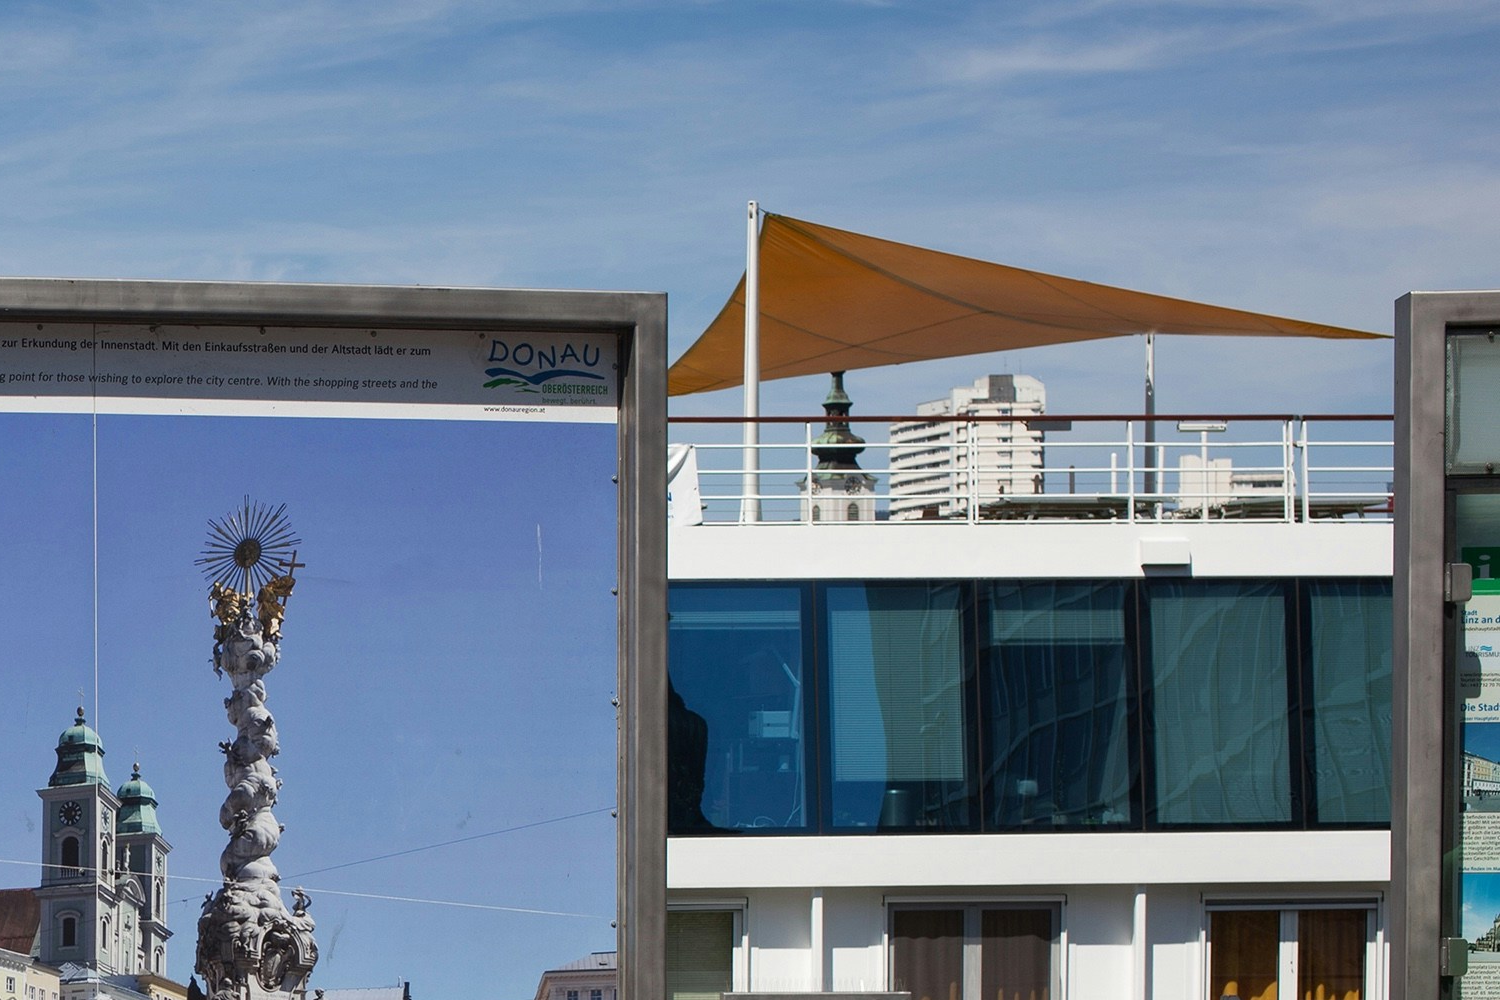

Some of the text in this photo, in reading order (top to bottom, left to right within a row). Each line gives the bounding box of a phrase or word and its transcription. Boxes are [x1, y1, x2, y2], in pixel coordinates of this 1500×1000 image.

[1, 341, 18, 349] zur
[21, 339, 77, 351] Erkundung
[80, 340, 98, 350] der
[101, 340, 159, 351] Innenstadt.
[161, 341, 180, 351] Mit
[182, 341, 202, 352] den
[204, 342, 287, 353] Einkaufsstraßen
[289, 343, 309, 354] und
[311, 343, 329, 354] der
[331, 344, 372, 354] Altstadt
[374, 345, 394, 355] lädt
[396, 347, 407, 355] er
[409, 348, 431, 356] zum
[488, 339, 600, 370] DONAU
[8, 372, 36, 385] point
[37, 373, 54, 383] for
[56, 373, 85, 383] those
[88, 373, 128, 386] wishing
[131, 374, 142, 384] to
[144, 374, 184, 387] explore
[186, 375, 203, 385] the
[205, 375, 225, 388] city
[227, 375, 263, 386] centre.
[266, 376, 291, 386] With
[293, 376, 310, 387] the
[313, 377, 359, 390] shopping
[361, 377, 397, 388] streets
[399, 378, 419, 388] and
[420, 378, 438, 389] the
[542, 382, 608, 395] OBERÖSTERREICH
[484, 406, 546, 414] www.donauregion.at
[1461, 615, 1479, 624] Linz
[1461, 703, 1500, 711] Die Stad
